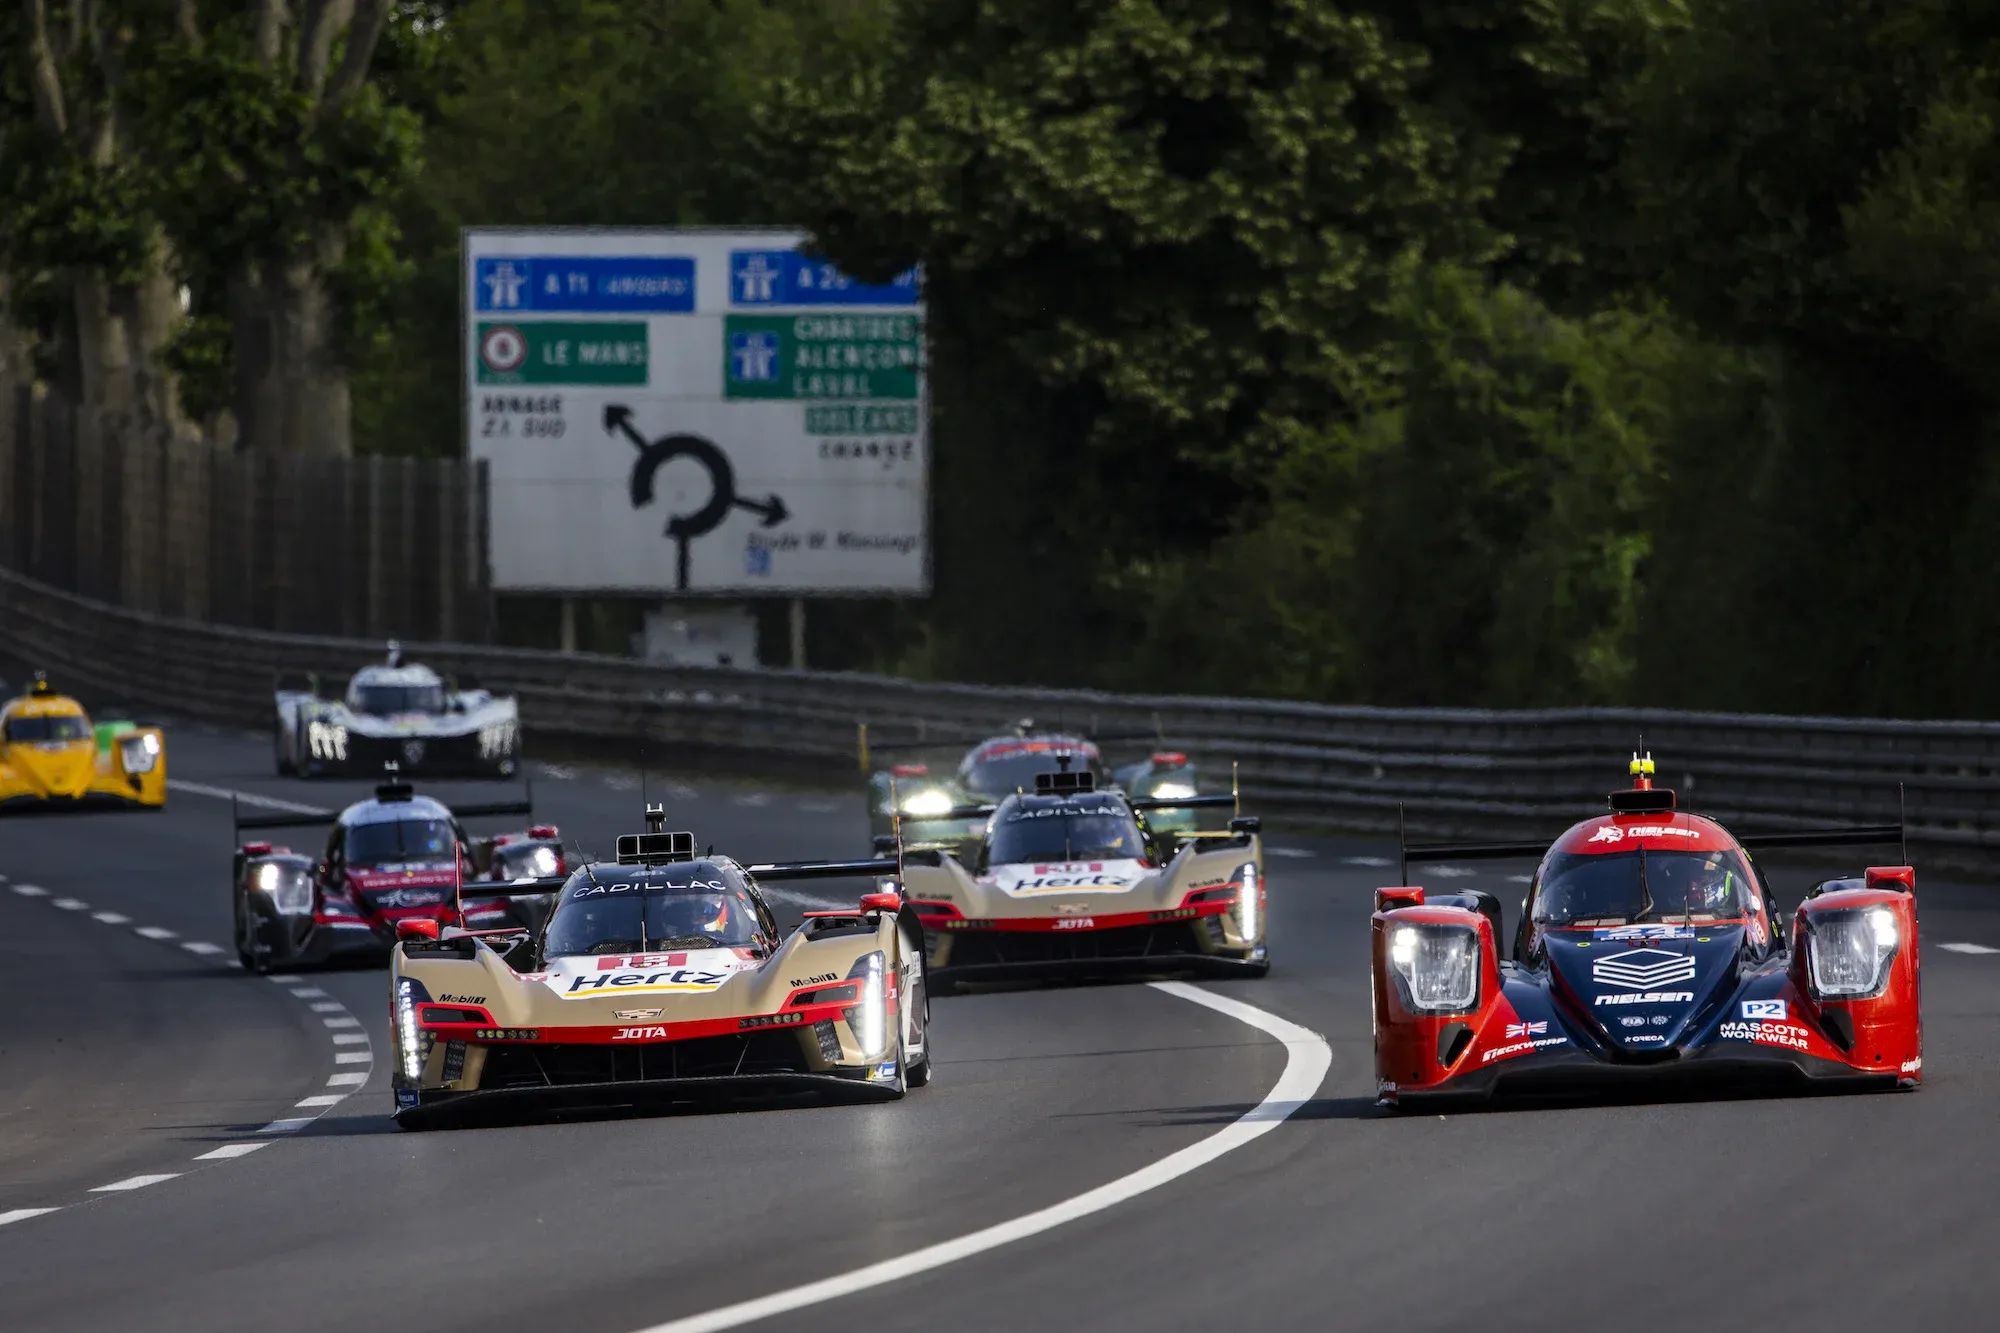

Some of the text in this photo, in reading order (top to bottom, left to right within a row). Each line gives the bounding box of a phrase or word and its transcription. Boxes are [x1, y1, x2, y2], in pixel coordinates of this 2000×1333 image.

[798, 266, 814, 289] A
[542, 340, 646, 367] LE MANS
[573, 880, 726, 898] CADILLAC
[1014, 875, 1129, 891] Hertz
[568, 970, 728, 992] Hertz
[1594, 991, 1694, 1006] NIELSEN
[1746, 1003, 1782, 1015] P2
[612, 1027, 667, 1040] JOTA
[1720, 1030, 1809, 1050] WORKWEAR
